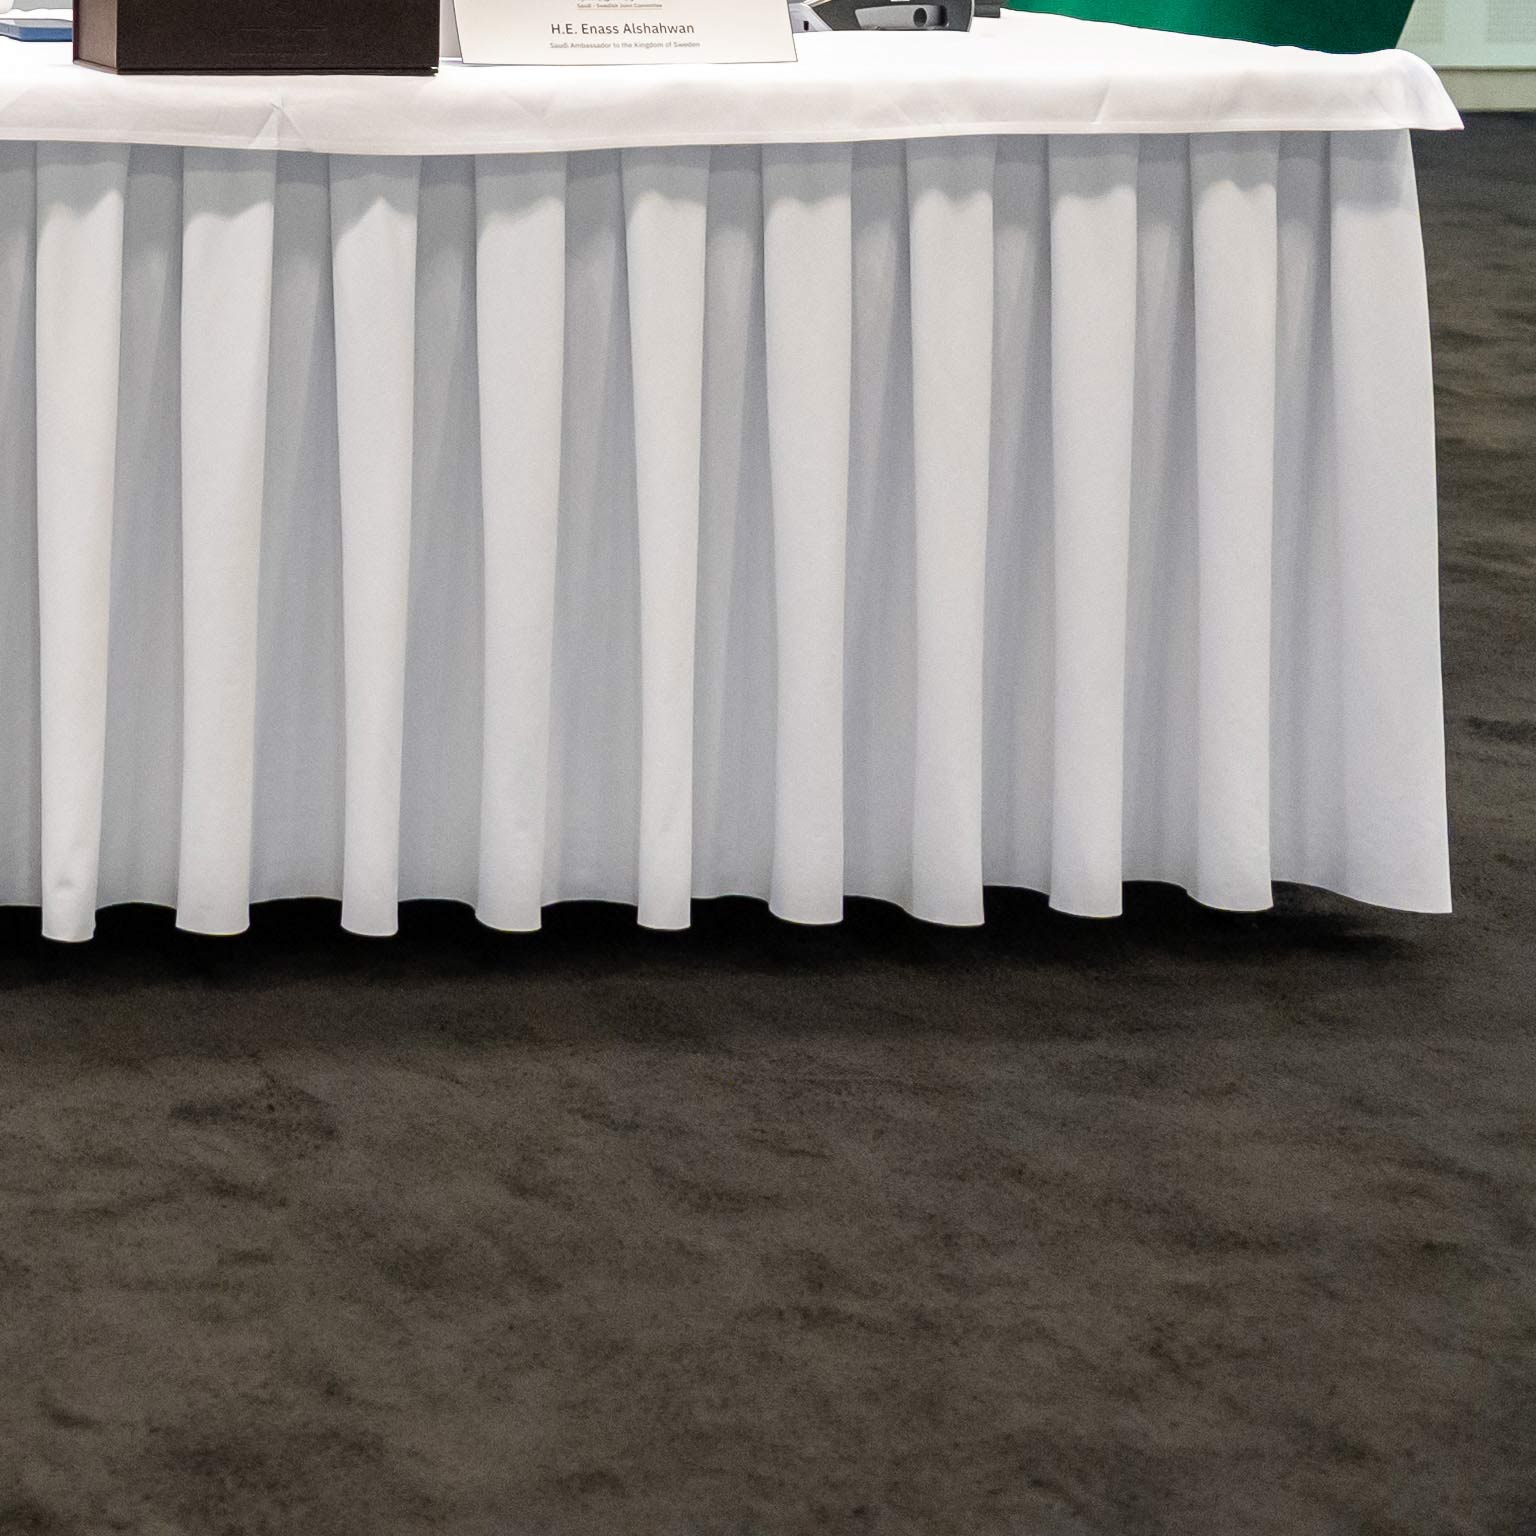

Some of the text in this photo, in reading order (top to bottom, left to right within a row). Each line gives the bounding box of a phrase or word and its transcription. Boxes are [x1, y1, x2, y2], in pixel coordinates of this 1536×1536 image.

[550, 22, 695, 35] H.E. Enass Alshahwan
